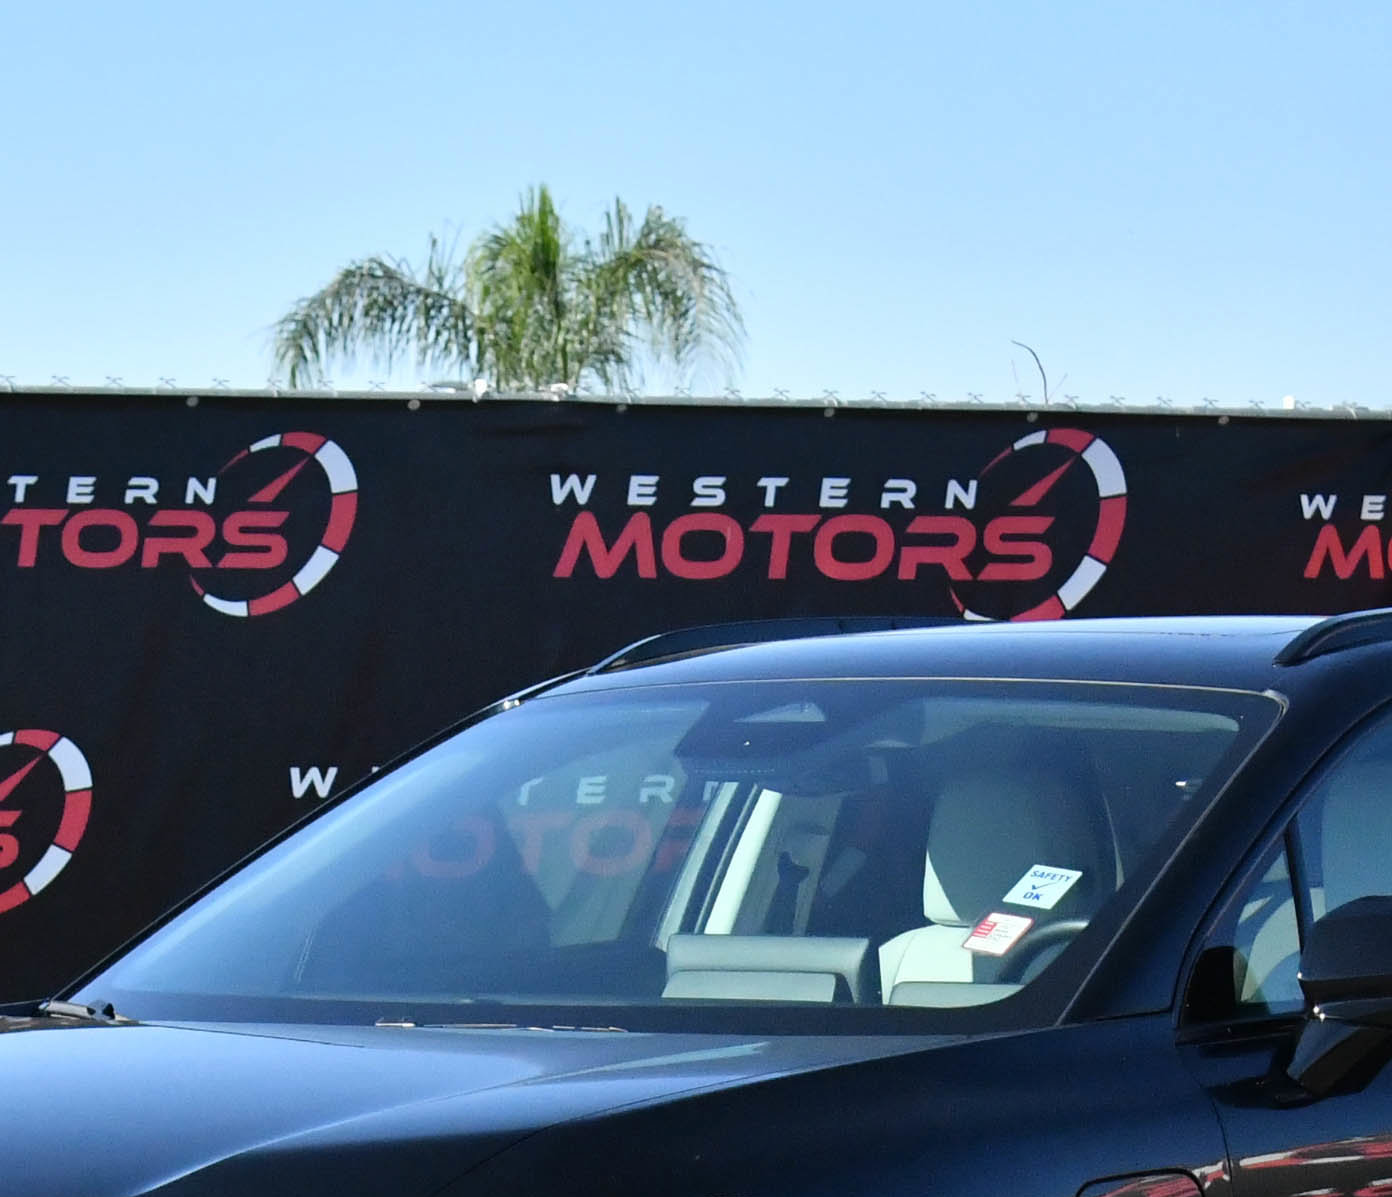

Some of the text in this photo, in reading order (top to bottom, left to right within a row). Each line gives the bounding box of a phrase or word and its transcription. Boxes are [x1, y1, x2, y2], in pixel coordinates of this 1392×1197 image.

[551, 474, 978, 509] WESTERN
[554, 511, 1054, 581] MOTORS
[1030, 869, 1073, 883] SAFETY
[1022, 891, 1044, 901] OK
